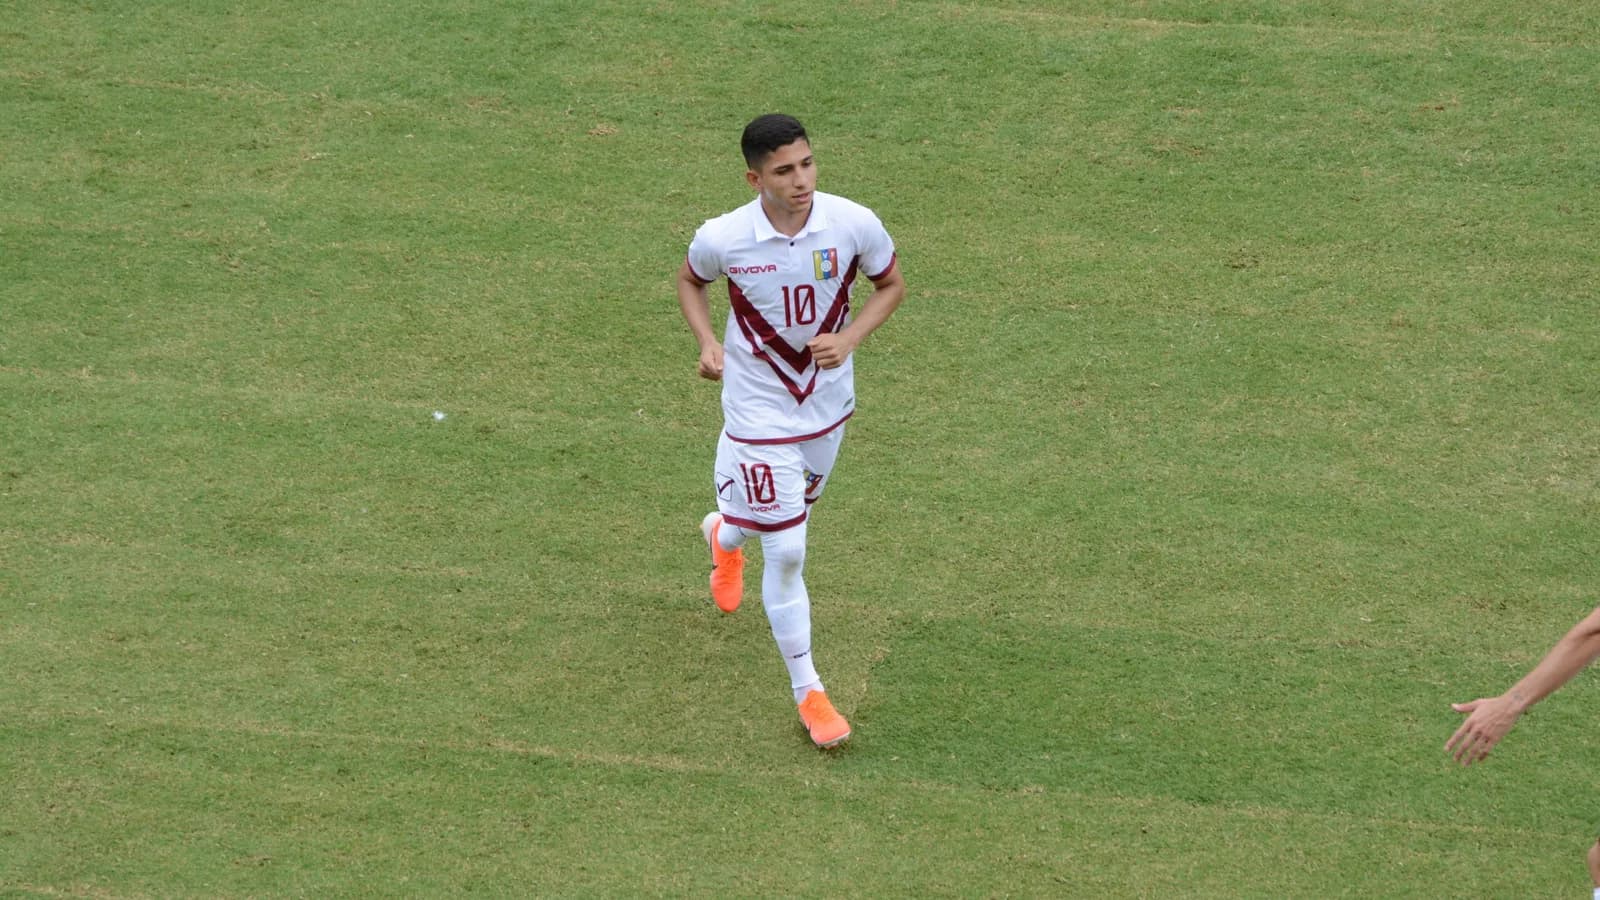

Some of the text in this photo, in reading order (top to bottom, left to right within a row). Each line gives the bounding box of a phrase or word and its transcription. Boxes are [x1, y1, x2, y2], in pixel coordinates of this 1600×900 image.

[729, 264, 777, 274] GIVOVA
[782, 284, 816, 328] 10
[740, 463, 776, 504] 10
[750, 503, 780, 513] IVOVA
